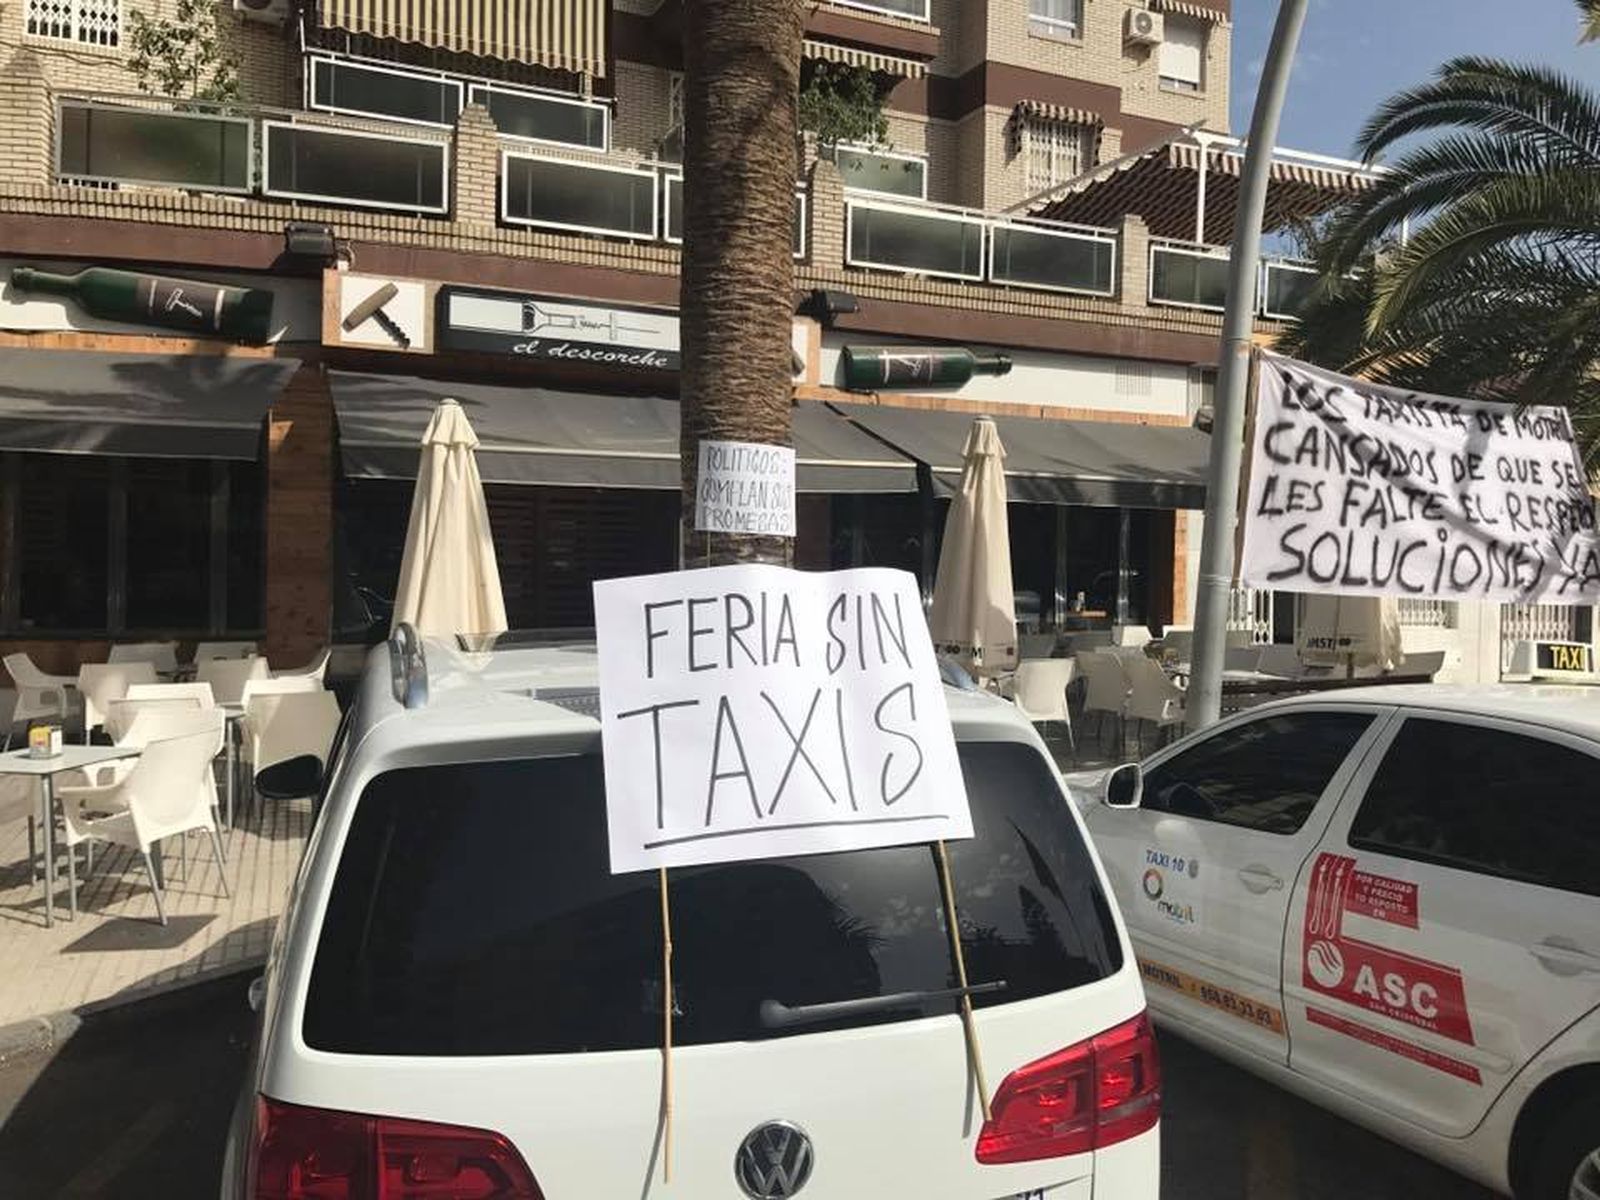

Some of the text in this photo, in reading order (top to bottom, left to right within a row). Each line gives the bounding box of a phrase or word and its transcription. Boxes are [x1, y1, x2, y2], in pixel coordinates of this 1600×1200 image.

[513, 339, 668, 368] el descorche
[1475, 409, 1507, 436] DE
[1264, 422, 1581, 489] CANSADOS DE QUE SE
[1258, 475, 1327, 516] LES
[1339, 478, 1450, 530] FALTE
[1459, 492, 1499, 525] EL
[644, 591, 913, 679] FERIA SIN
[1549, 645, 1586, 671] TAXI
[616, 682, 924, 829] TAXIS
[1146, 849, 1185, 873] TAXI 10
[1354, 963, 1438, 1019] ASC
